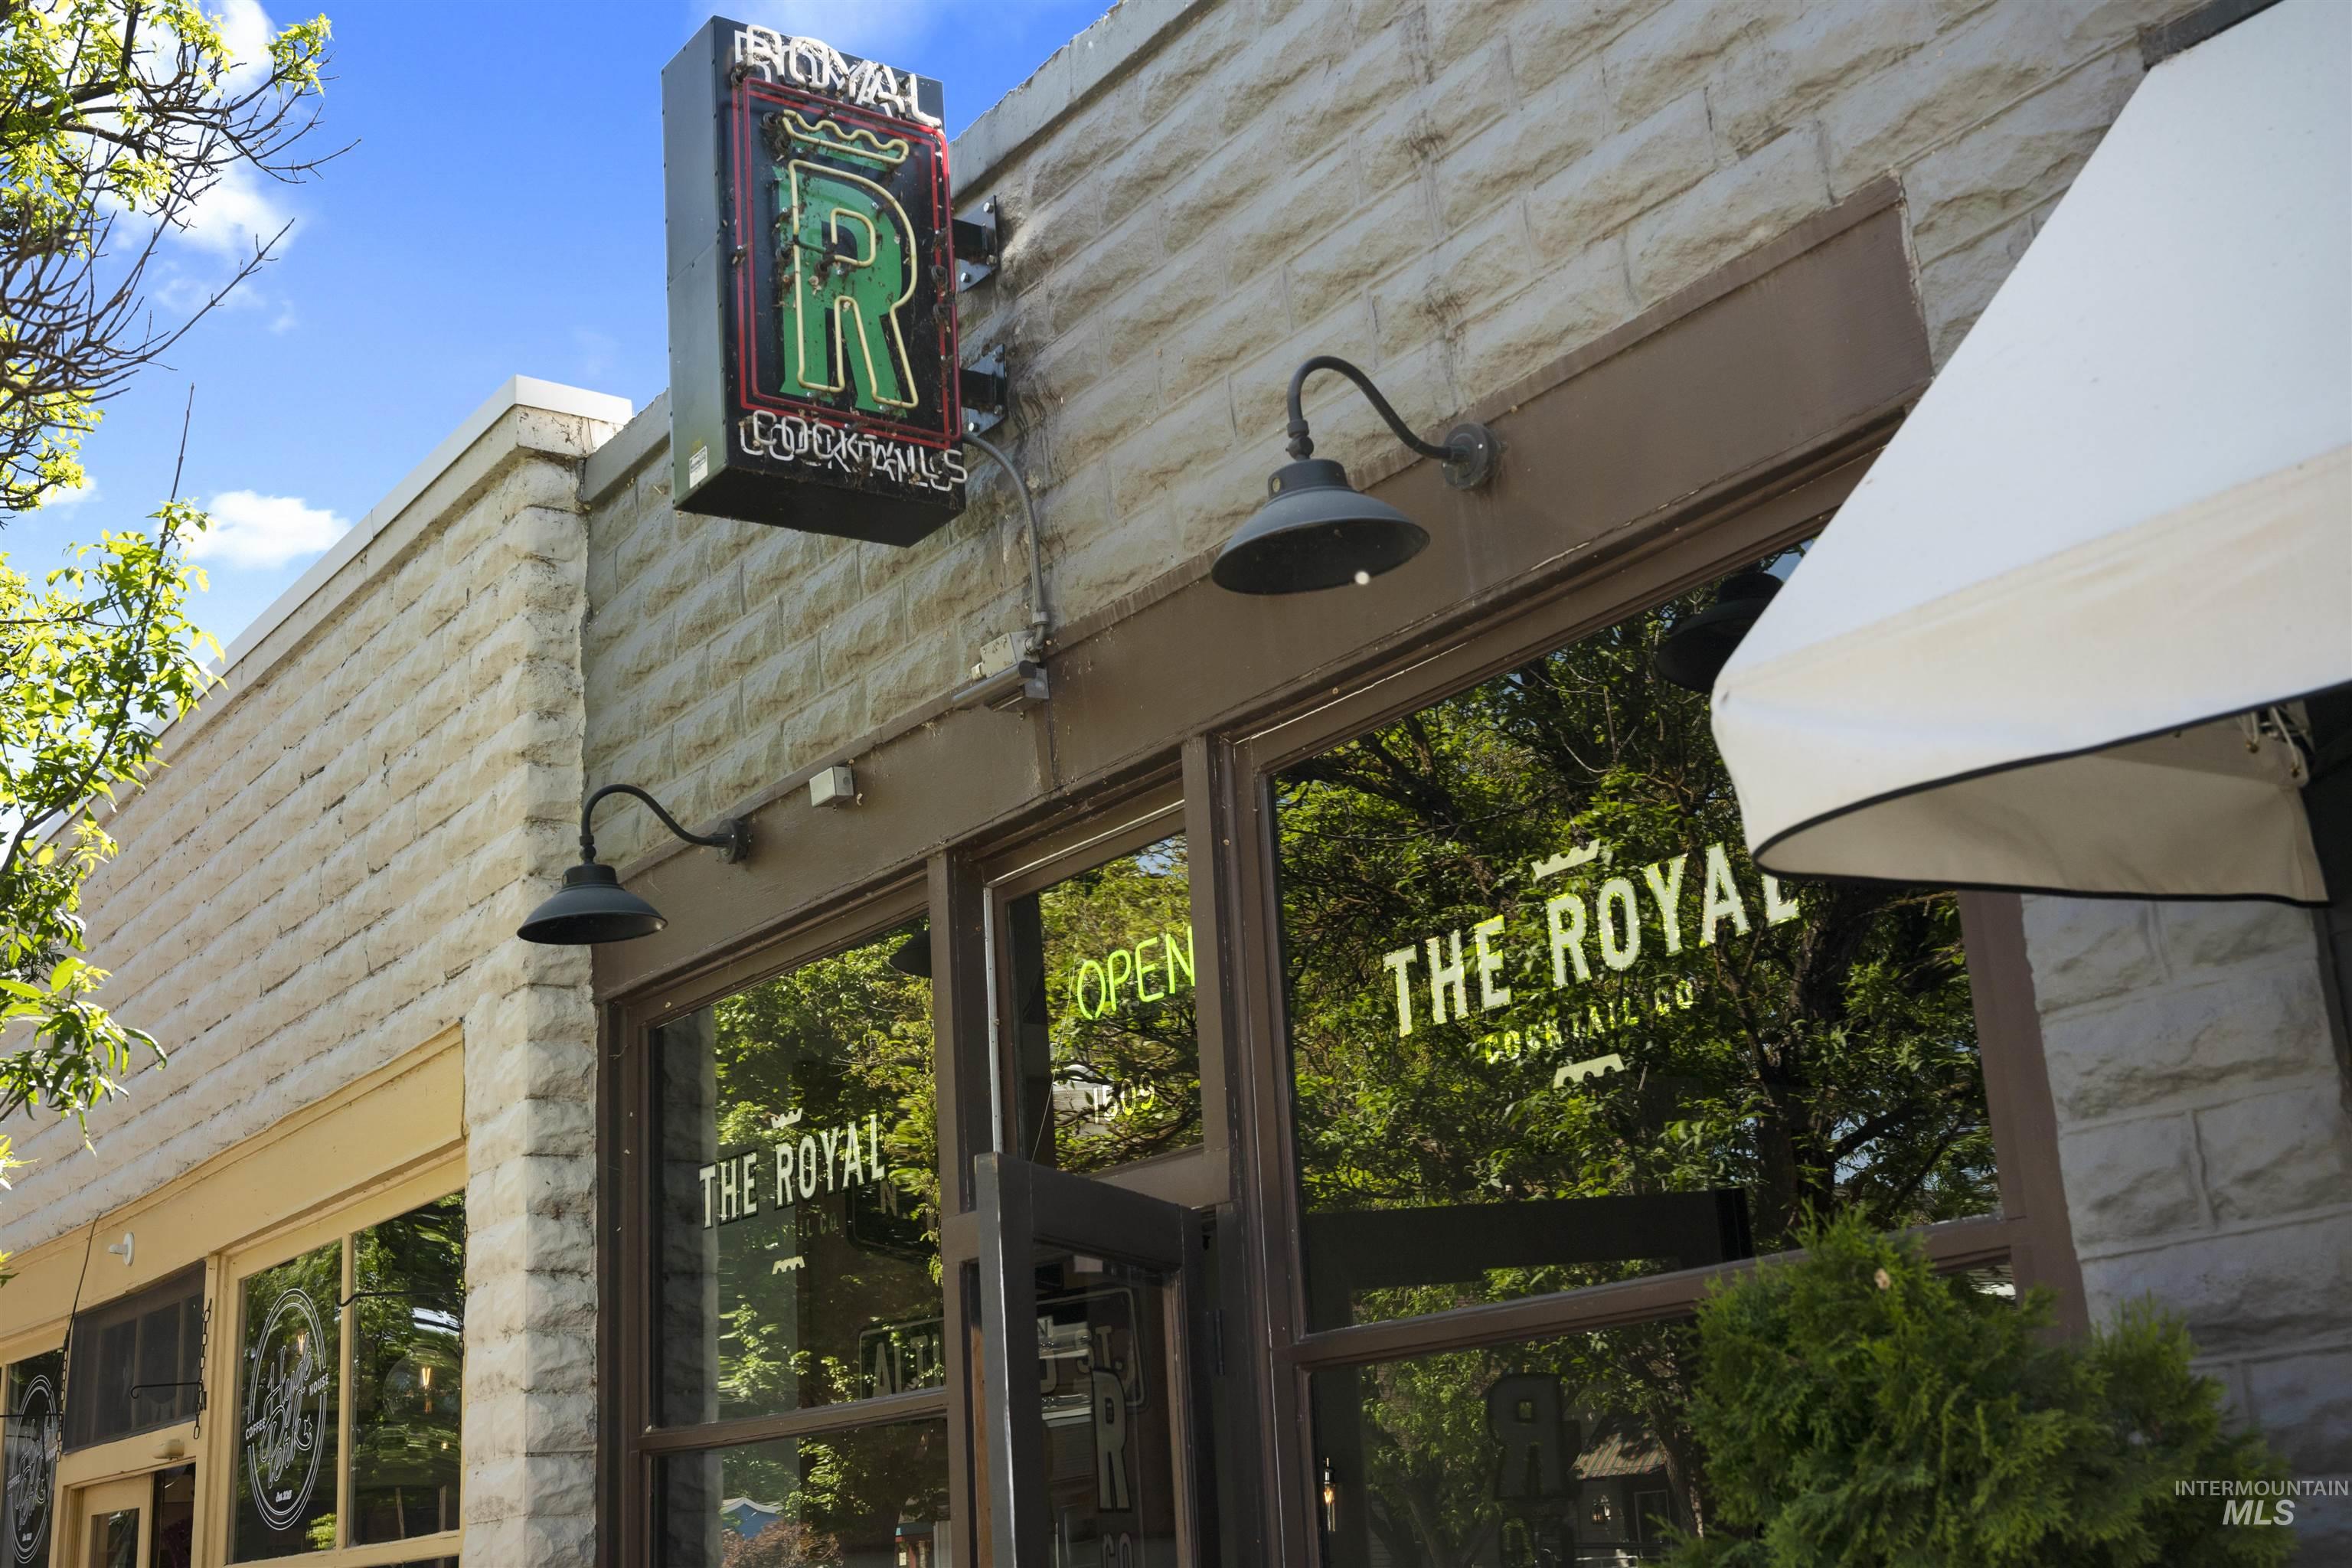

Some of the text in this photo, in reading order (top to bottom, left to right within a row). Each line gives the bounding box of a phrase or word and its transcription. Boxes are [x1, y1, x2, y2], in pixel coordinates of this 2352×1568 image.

[733, 24, 941, 128] ROYAL
[773, 158, 918, 418] R
[740, 410, 968, 491] COCKTAILS
[1077, 926, 1195, 1020] OPEN
[1383, 914, 1511, 1037] THE
[699, 1114, 884, 1228] THE ROYAL
[245, 1416, 266, 1440] COFFEE
[309, 1373, 329, 1396] HOUSE
[1091, 1367, 1132, 1512] R
